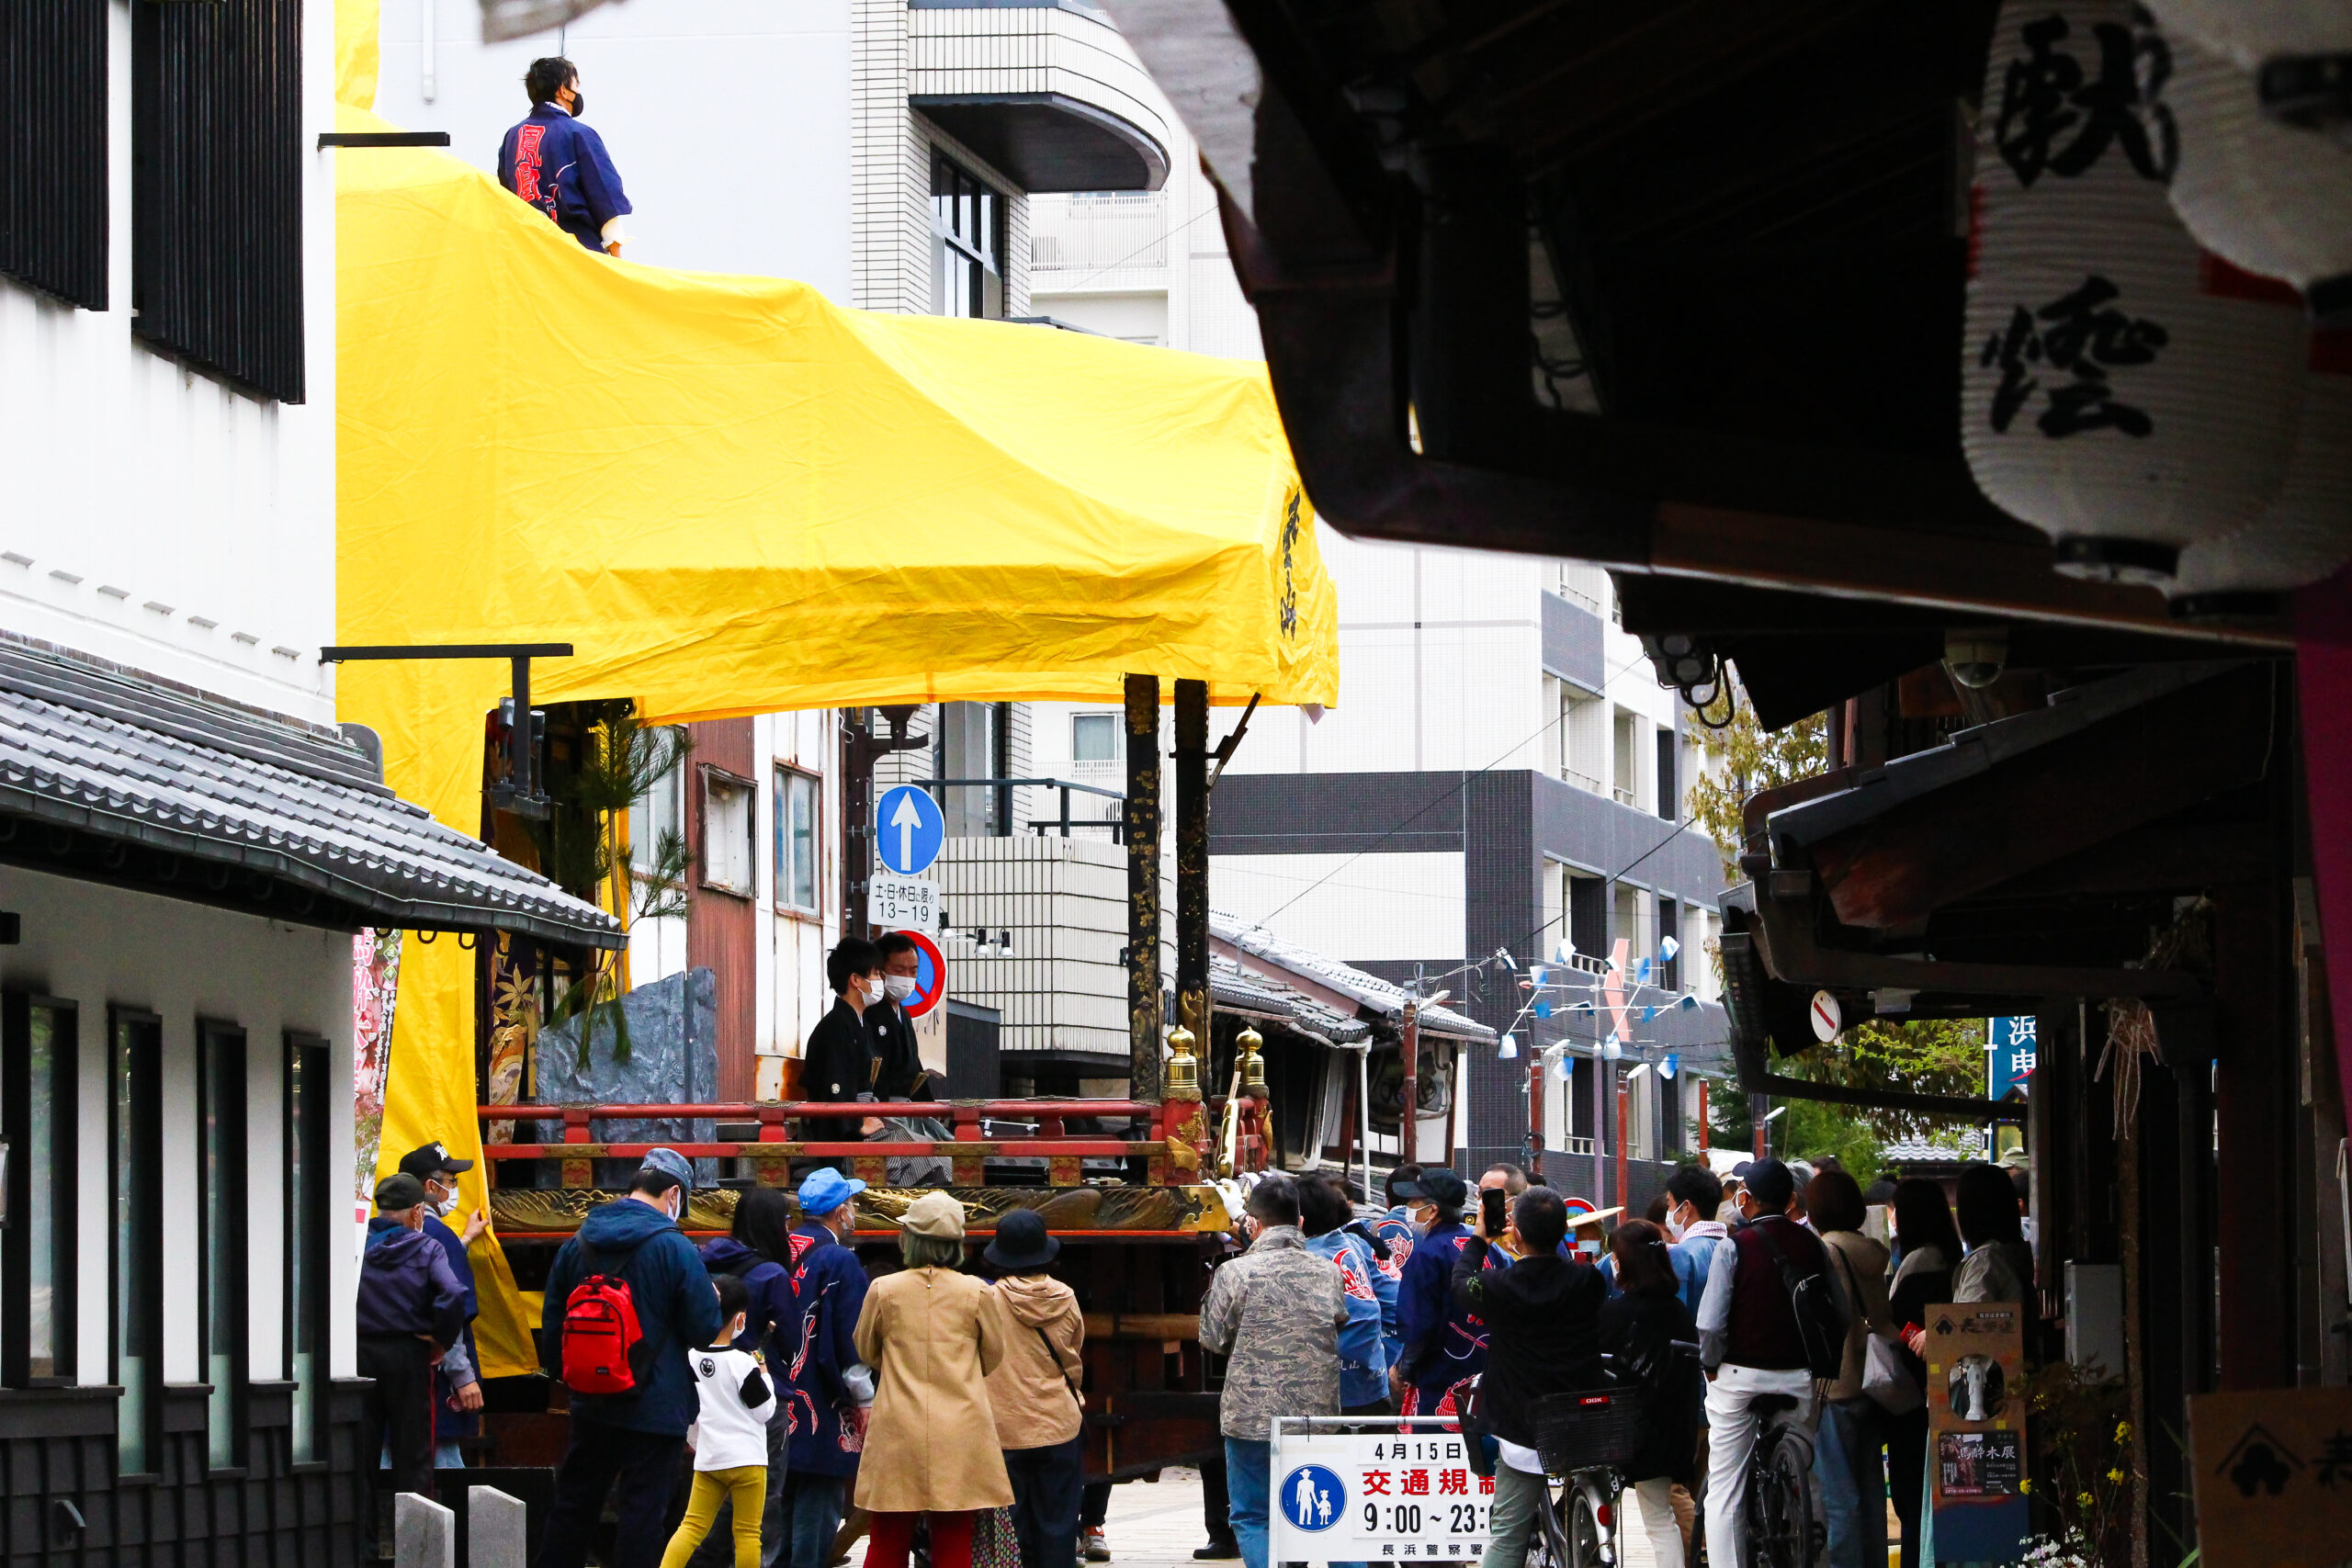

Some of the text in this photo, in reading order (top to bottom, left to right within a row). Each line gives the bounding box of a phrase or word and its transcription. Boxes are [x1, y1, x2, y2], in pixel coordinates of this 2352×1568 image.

[1382, 1543, 1483, 1557] 長浜警察署
